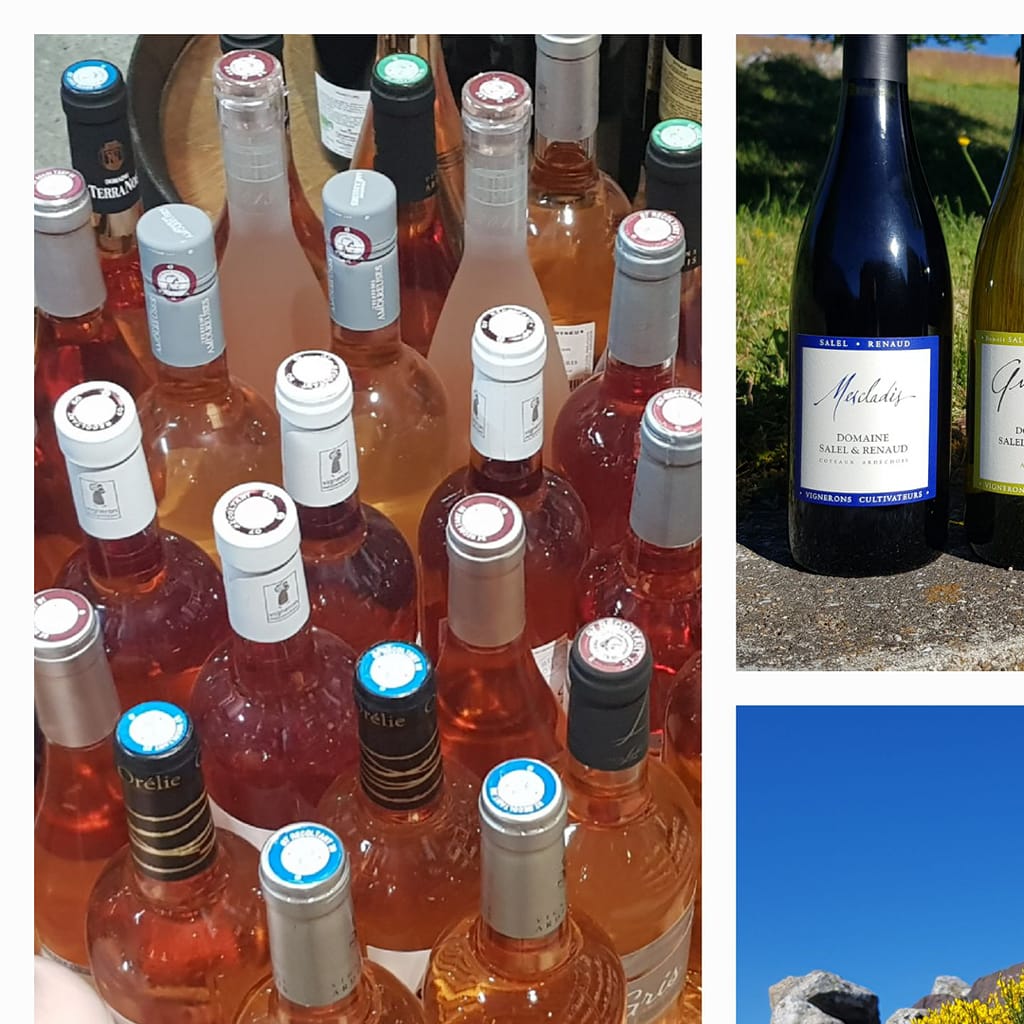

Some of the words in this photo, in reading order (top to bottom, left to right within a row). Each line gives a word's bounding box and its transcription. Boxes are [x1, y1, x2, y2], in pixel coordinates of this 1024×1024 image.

[819, 339, 848, 347] SALEL
[868, 340, 911, 348] RENAUD
[837, 433, 889, 442] DOMAINE
[819, 444, 849, 454] SALEL
[851, 446, 860, 454] &
[863, 444, 908, 454] RENAUD
[806, 491, 852, 503] VIGNERONS
[859, 491, 923, 503] CULTIVATEURS
